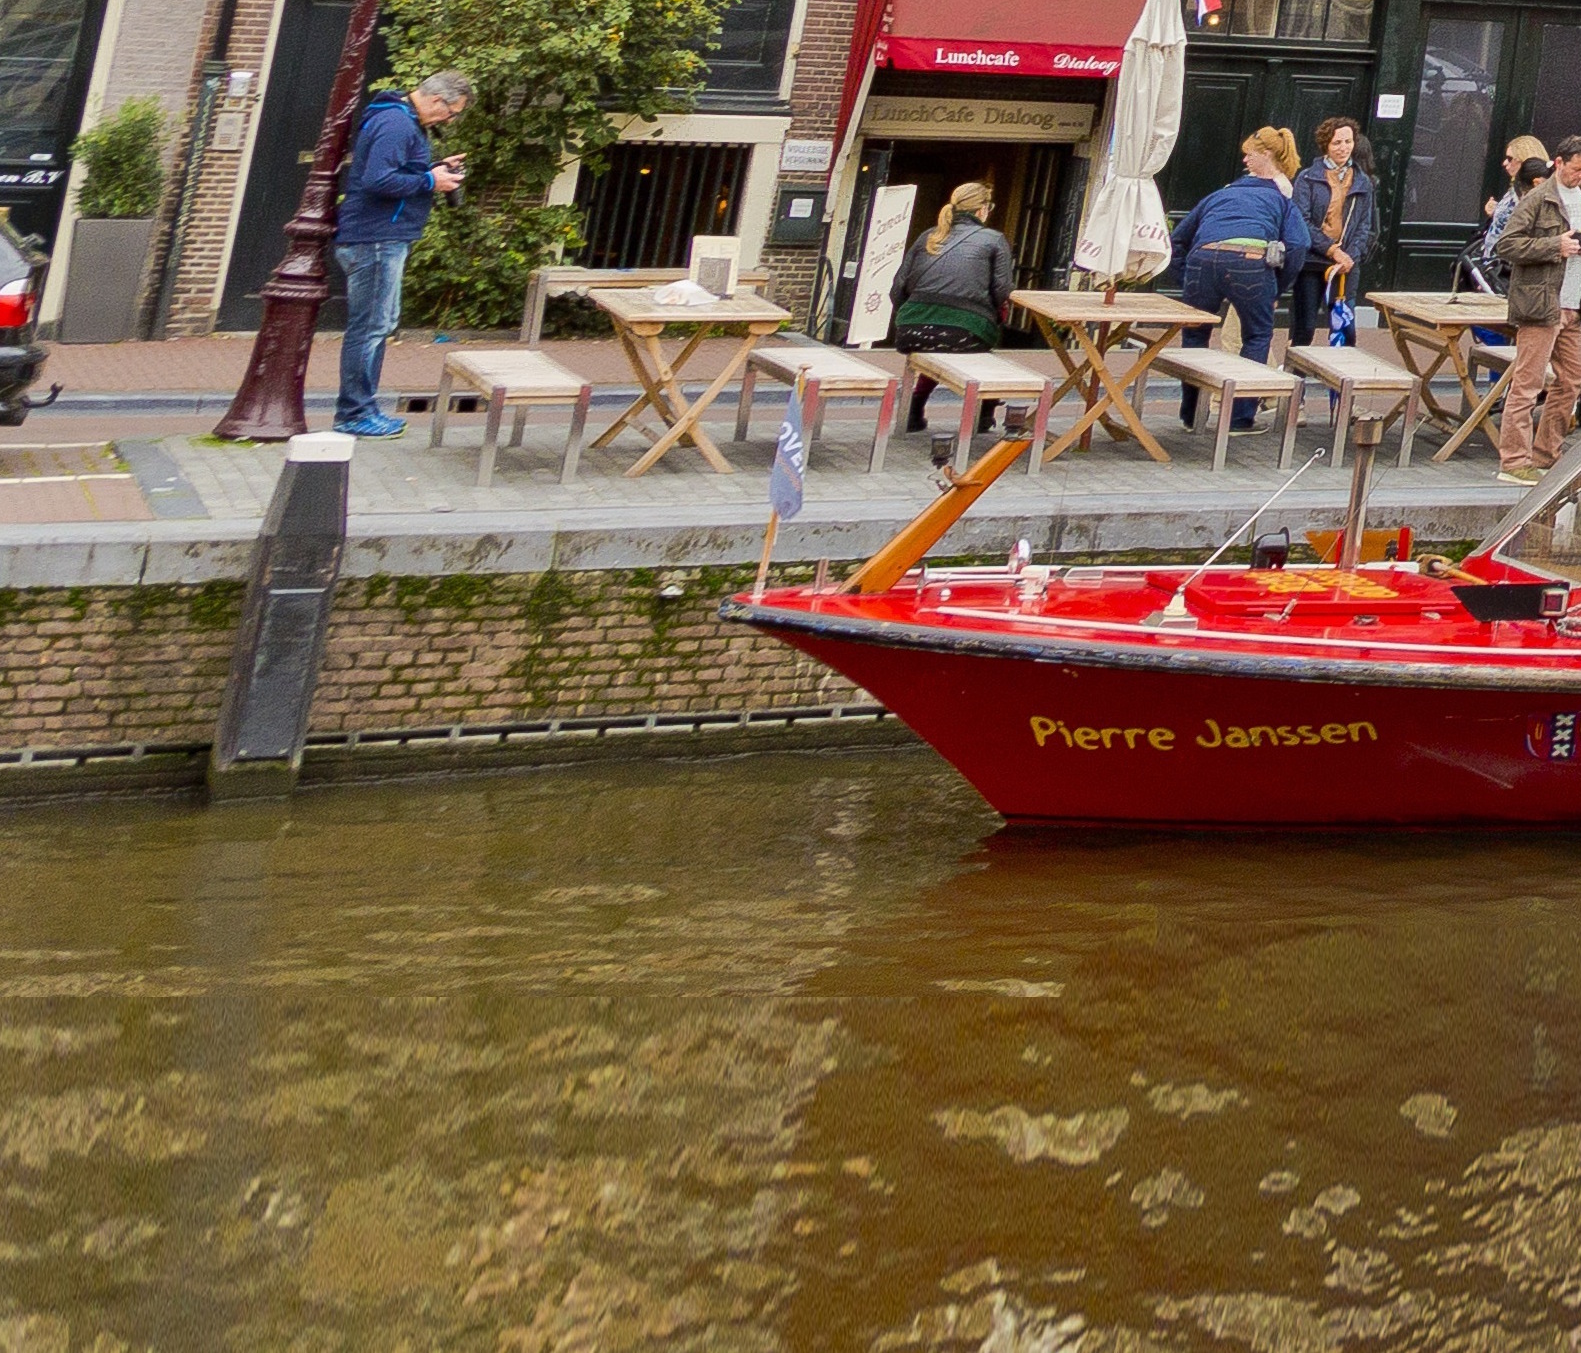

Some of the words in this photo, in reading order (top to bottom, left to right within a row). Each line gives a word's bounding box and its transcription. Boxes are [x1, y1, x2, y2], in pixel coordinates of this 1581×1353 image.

[935, 48, 1020, 66] Lunchcafe
[1053, 53, 1121, 75] Dialoog
[871, 104, 974, 123] LunchCafe
[983, 107, 1055, 130] Dialoog
[1029, 715, 1176, 751] Pierre
[1196, 718, 1378, 749] Janssen
